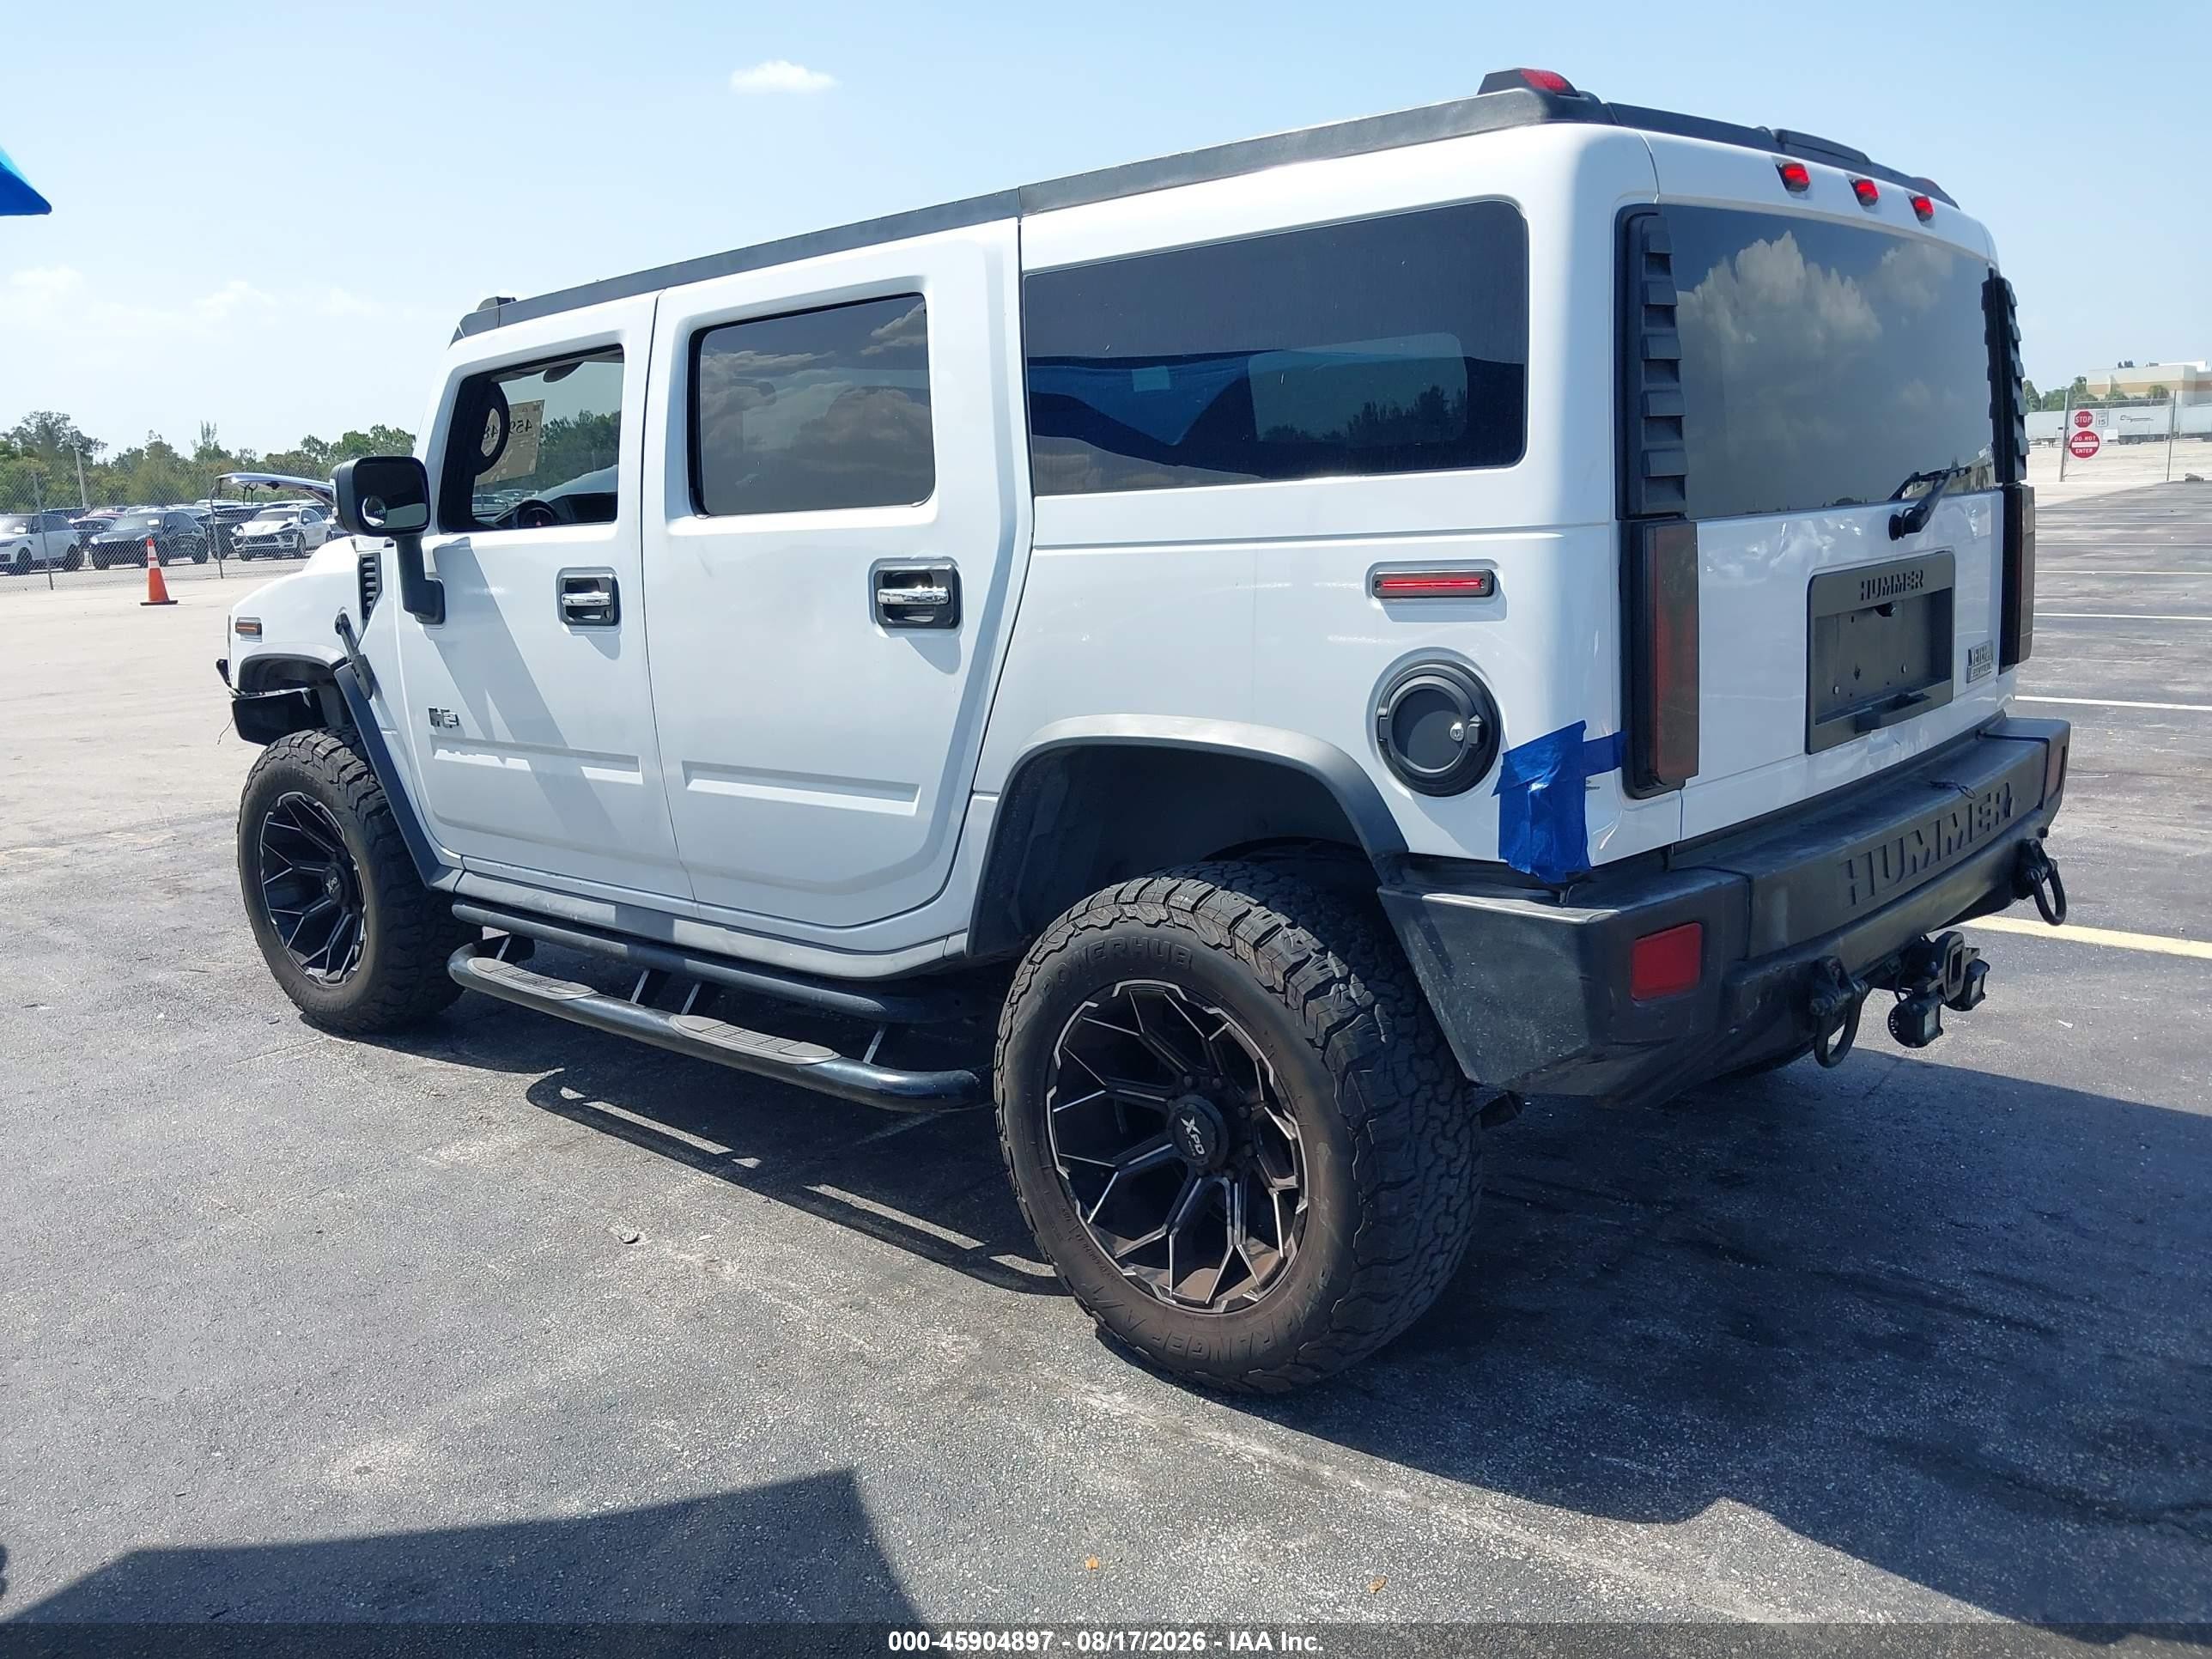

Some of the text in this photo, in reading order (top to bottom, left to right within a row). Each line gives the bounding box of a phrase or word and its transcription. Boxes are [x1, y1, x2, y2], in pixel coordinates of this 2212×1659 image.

[1860, 570, 1923, 600] HUMMER
[428, 708, 459, 728] H2
[1838, 782, 2014, 907] HUMMER
